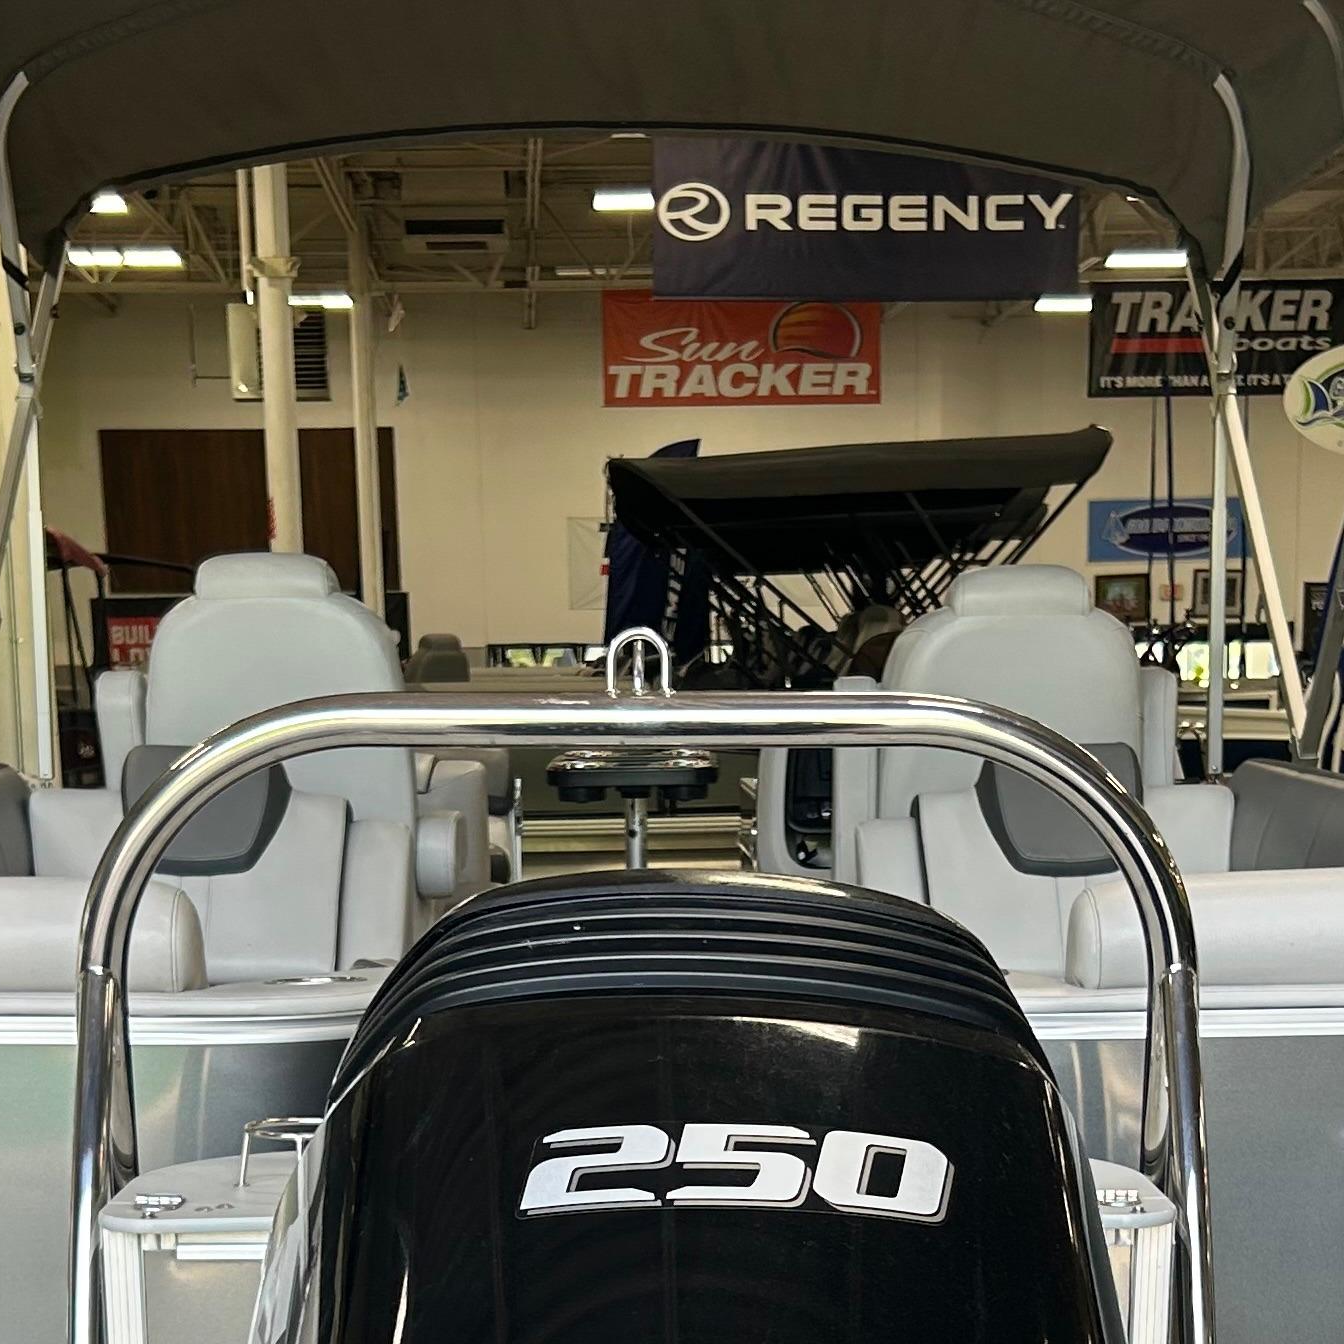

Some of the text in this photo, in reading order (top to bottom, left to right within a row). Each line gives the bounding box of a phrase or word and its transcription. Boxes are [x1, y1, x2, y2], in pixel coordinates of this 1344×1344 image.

[744, 192, 1074, 232] REGENCY
[1111, 290, 1333, 333] TRAKER
[621, 326, 765, 364] Sun
[608, 362, 874, 399] TRACKER
[519, 1123, 955, 1225] 250
